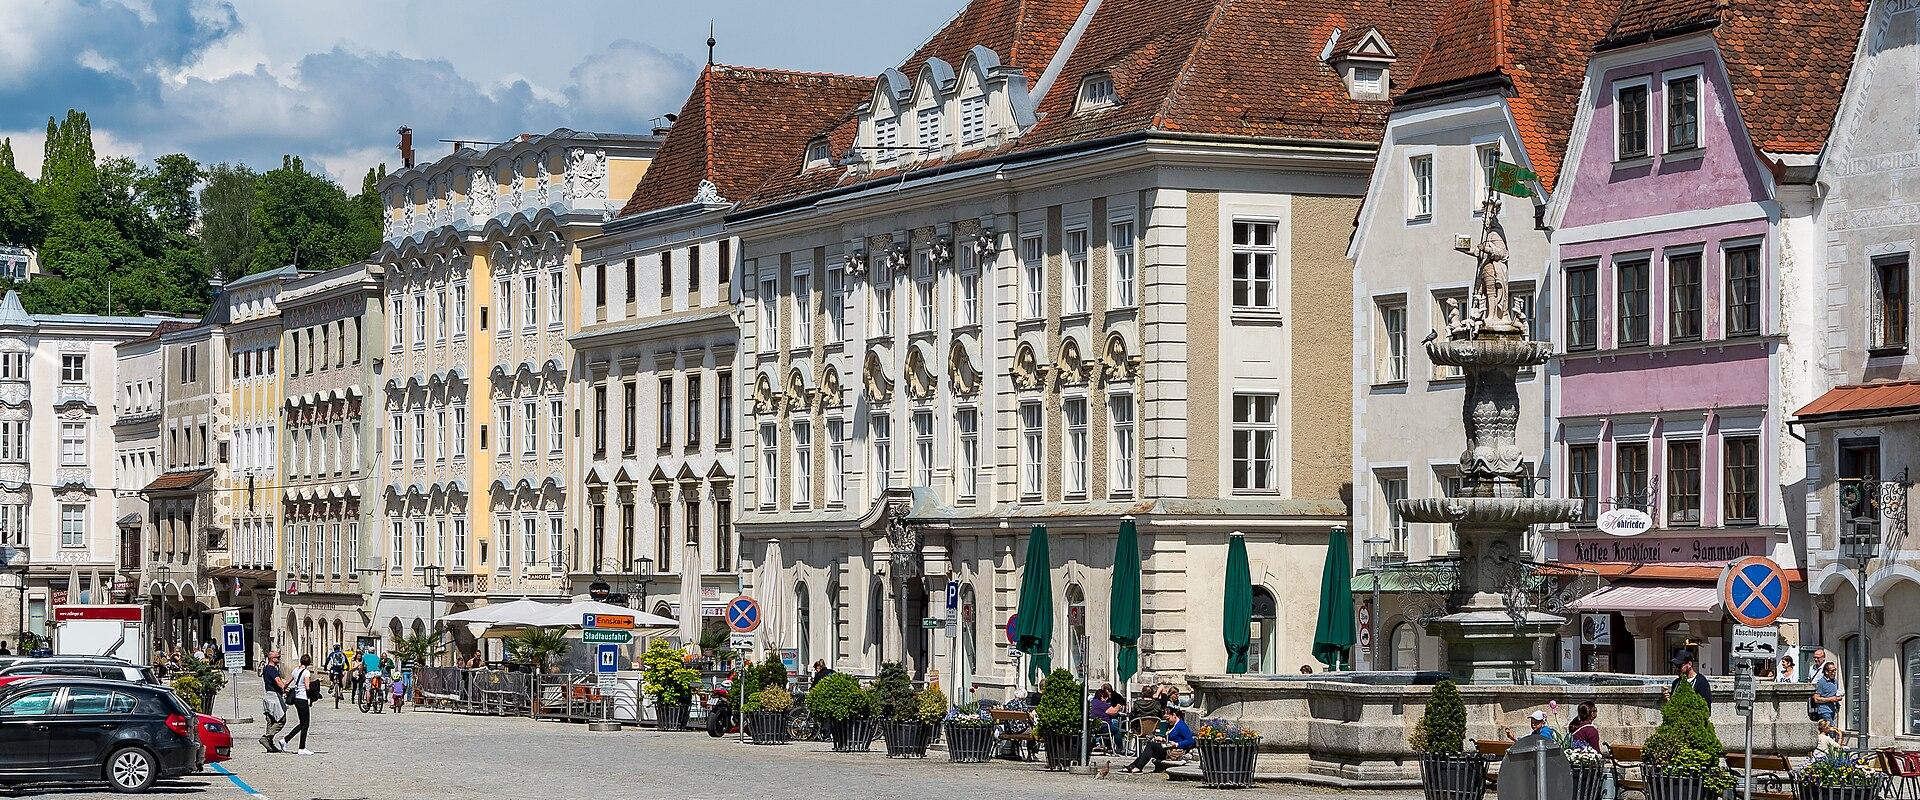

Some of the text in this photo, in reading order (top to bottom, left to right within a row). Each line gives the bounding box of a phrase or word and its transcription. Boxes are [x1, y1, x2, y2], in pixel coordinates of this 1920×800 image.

[1575, 541, 1608, 562] Kaffee
[949, 586, 956, 605] P
[586, 615, 622, 626] P Ennskai
[584, 631, 627, 641] Stadtausfahrt
[1735, 629, 1776, 638] Abschleppzone
